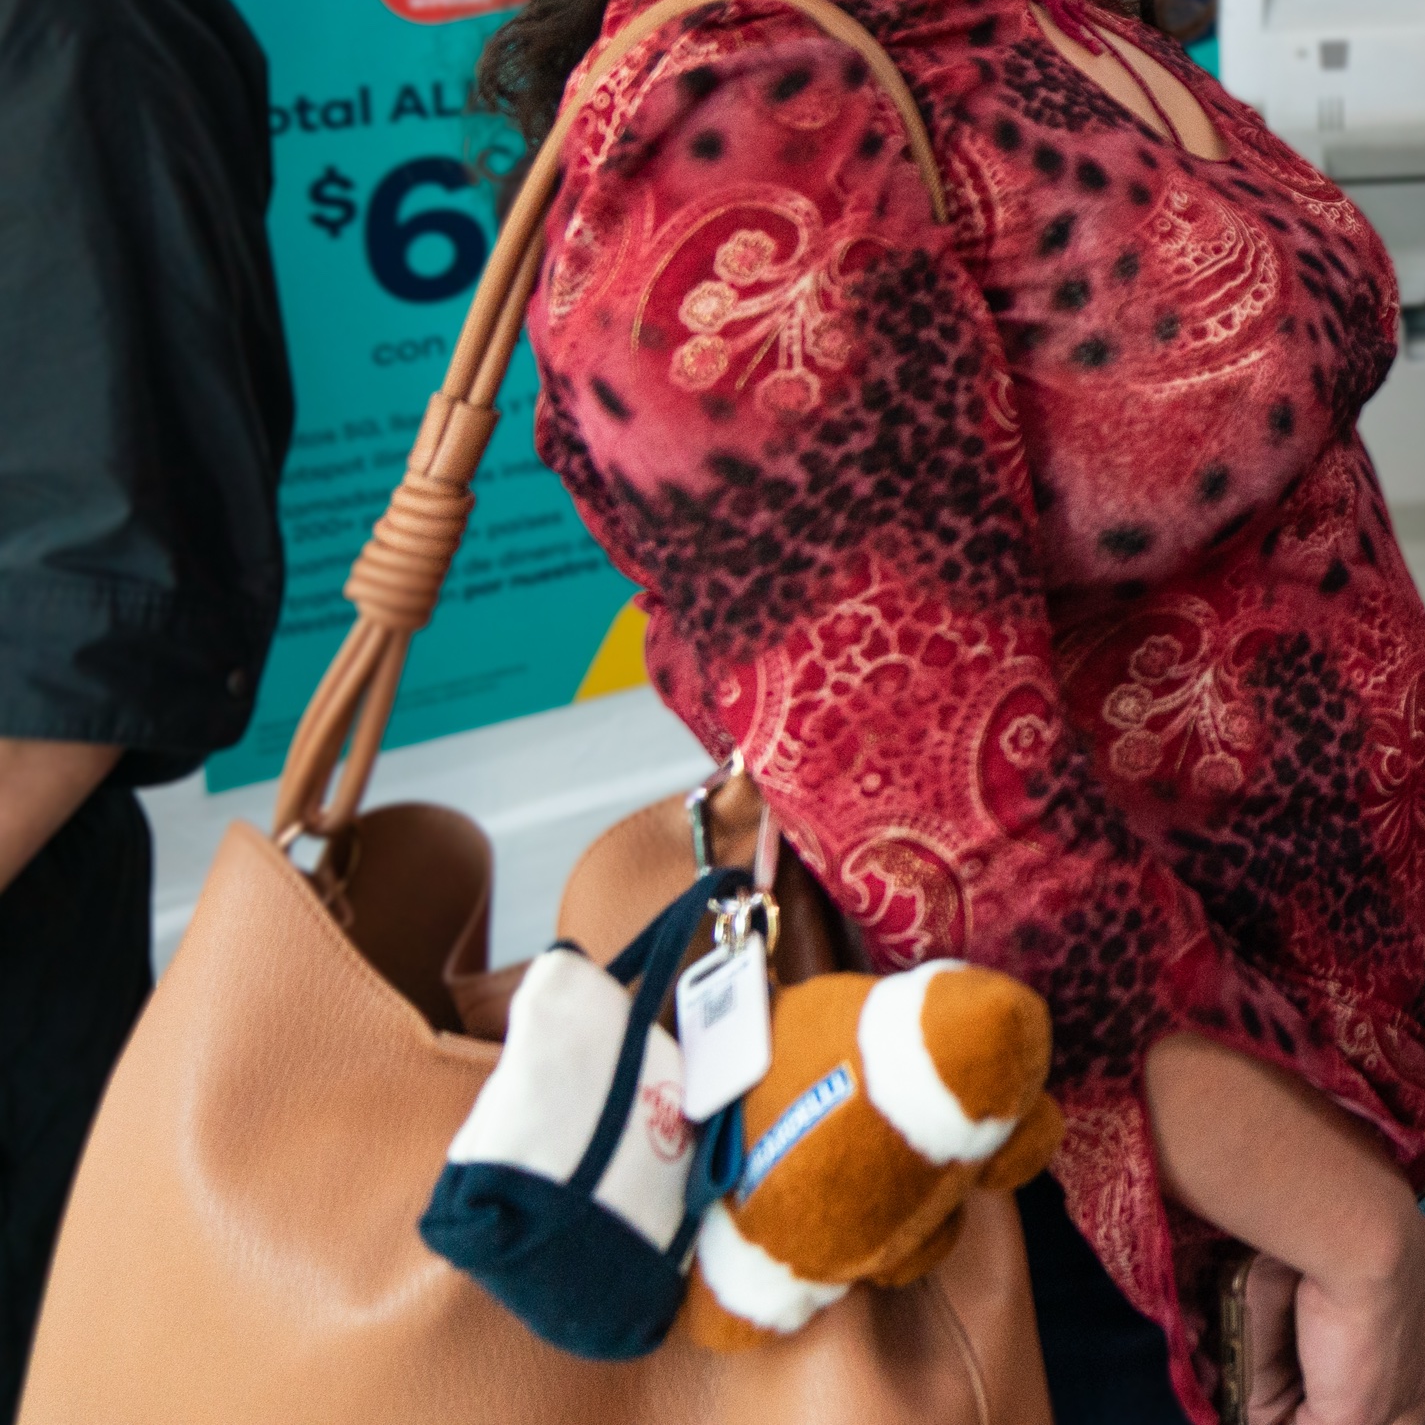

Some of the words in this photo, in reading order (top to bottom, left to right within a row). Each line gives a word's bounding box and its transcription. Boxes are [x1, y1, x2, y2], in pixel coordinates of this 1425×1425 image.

[269, 82, 373, 137] otal
[308, 152, 490, 306] $6
[371, 332, 447, 368] con
